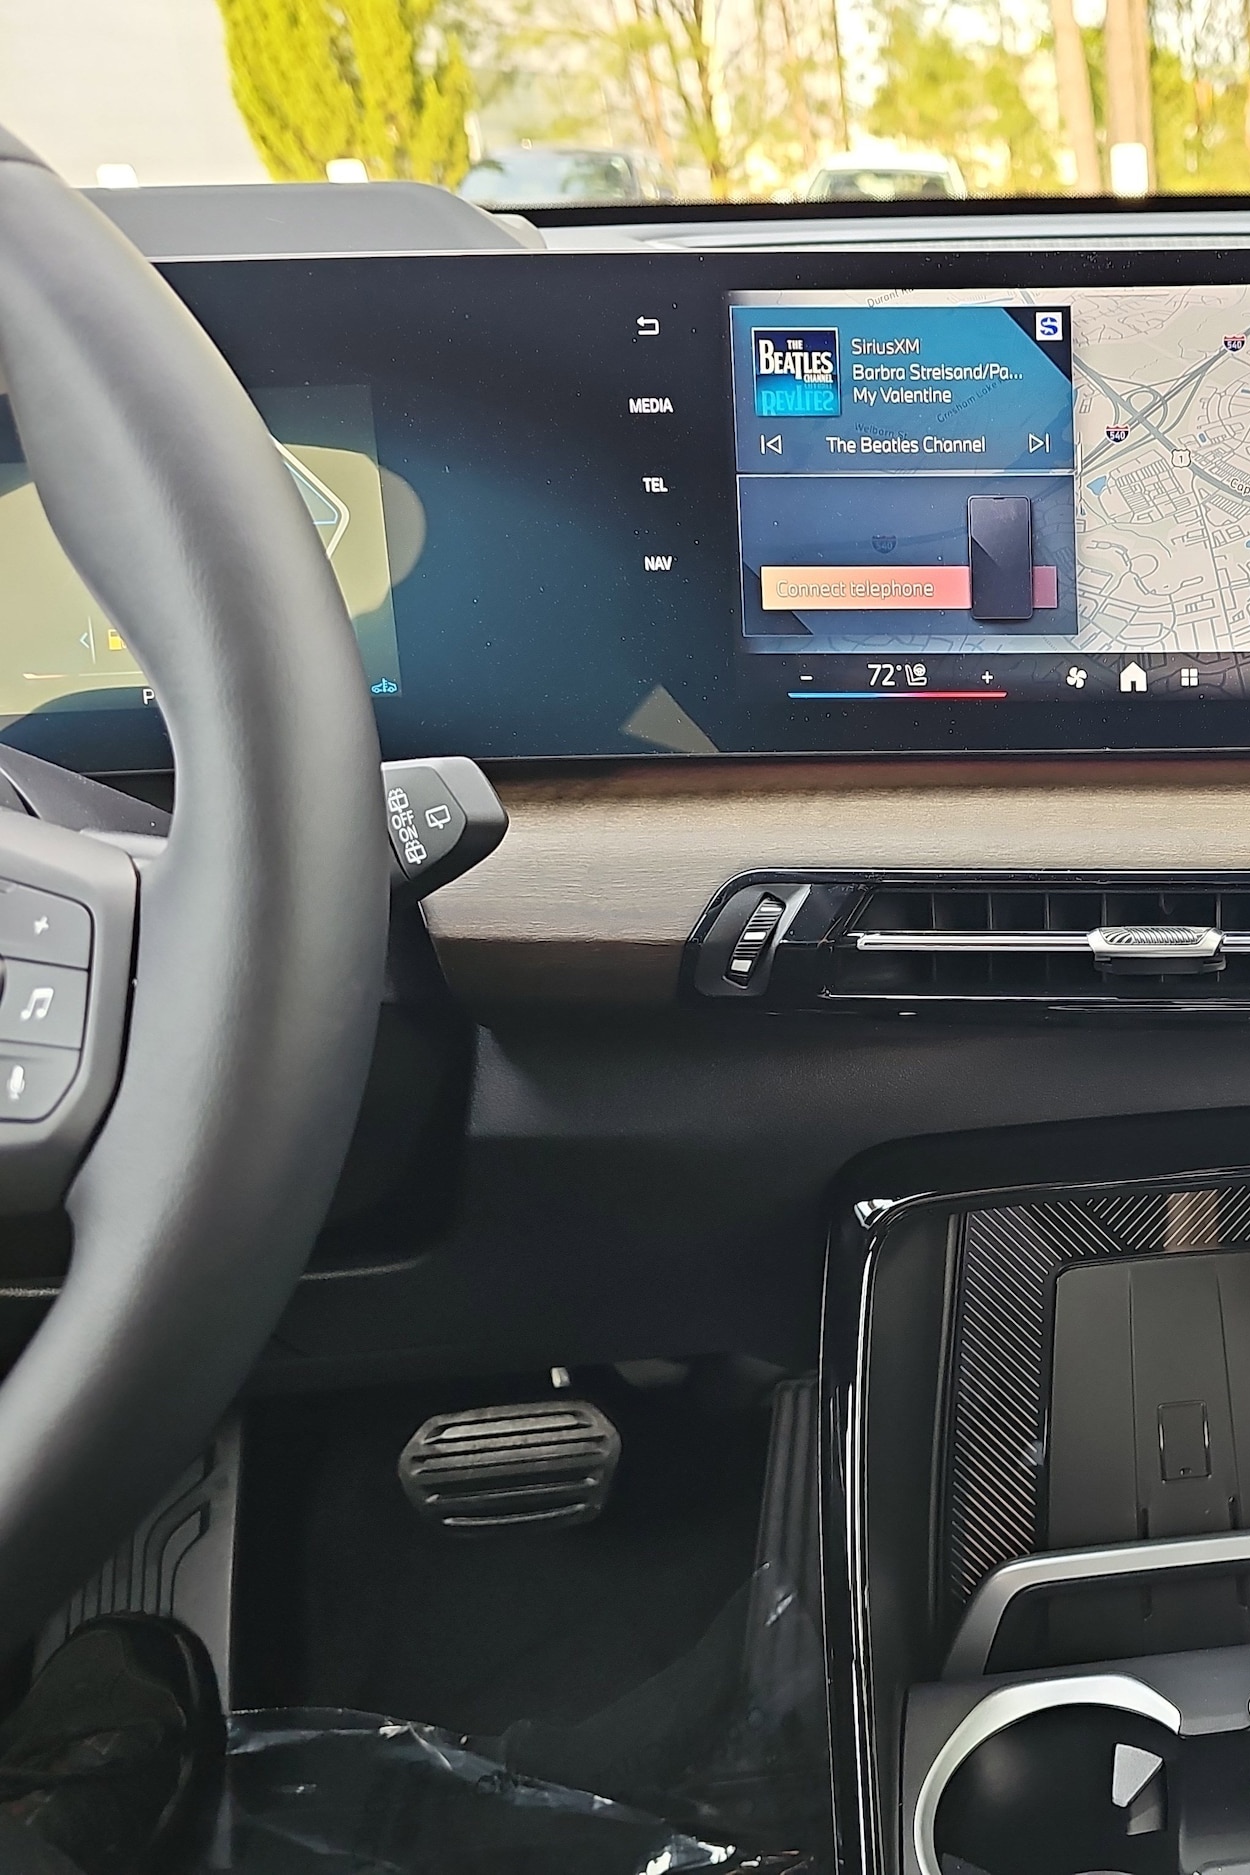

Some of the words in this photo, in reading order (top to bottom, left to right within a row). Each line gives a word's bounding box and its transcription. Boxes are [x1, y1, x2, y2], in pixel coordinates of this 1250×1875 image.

[786, 339, 803, 350] THE
[851, 338, 920, 355] SiriusXM
[1226, 340, 1242, 350] 540
[759, 339, 834, 380] BEATLES
[803, 374, 834, 384] CHANNEL
[852, 363, 906, 381] Barbra
[853, 387, 877, 406] My
[880, 387, 952, 404] Valentine
[977, 381, 997, 398] Lake
[628, 398, 674, 414] MEDIA
[1109, 430, 1126, 441] 540
[825, 436, 856, 453] The
[860, 436, 919, 453] Beatles
[922, 436, 986, 453] Channel
[642, 477, 668, 492] TEL
[644, 556, 672, 571] NAV
[776, 579, 846, 598] Connect
[849, 579, 934, 600] telephone
[867, 663, 902, 686] 72°
[142, 688, 155, 705] P
[391, 809, 414, 830] OFF
[399, 825, 419, 843] ON
